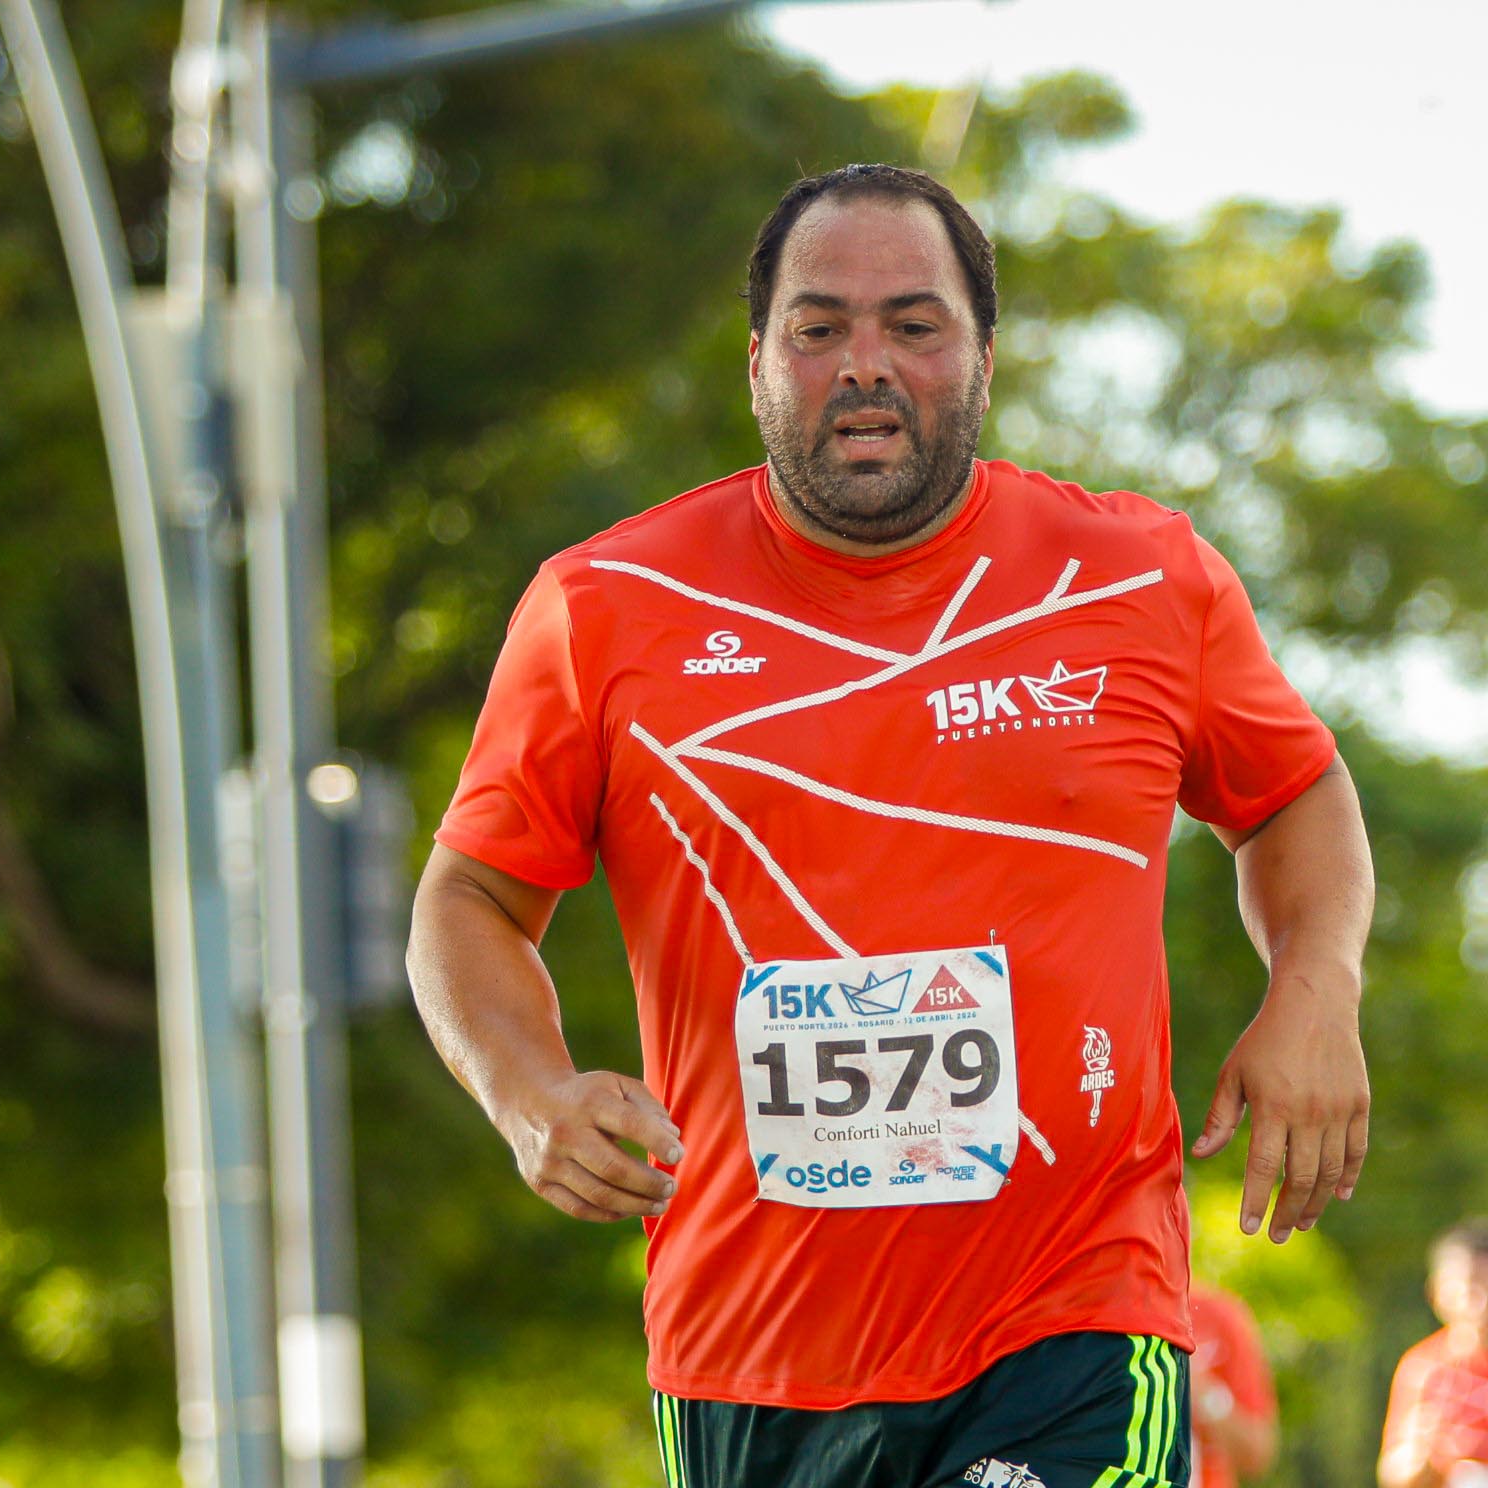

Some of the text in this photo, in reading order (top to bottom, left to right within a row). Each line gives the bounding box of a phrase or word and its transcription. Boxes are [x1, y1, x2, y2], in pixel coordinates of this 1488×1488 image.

[926, 677, 1022, 730] 15K
[937, 714, 1096, 744] PUERTO NORTE
[762, 983, 836, 1019] 15K
[926, 985, 964, 1006] 15K
[763, 1022, 796, 1031] PUERTO
[798, 1022, 827, 1031] NORTE
[857, 1018, 894, 1028] ROSARIO
[915, 1015, 927, 1023] DE
[929, 1013, 954, 1022] ABRIL
[752, 1028, 1001, 1117] 1579
[1080, 1069, 1115, 1092] ARDEC
[814, 1119, 942, 1142] Conforti Nahuel
[785, 1159, 873, 1189] osde
[936, 1165, 977, 1176] POWER
[952, 1173, 975, 1182] ADE
